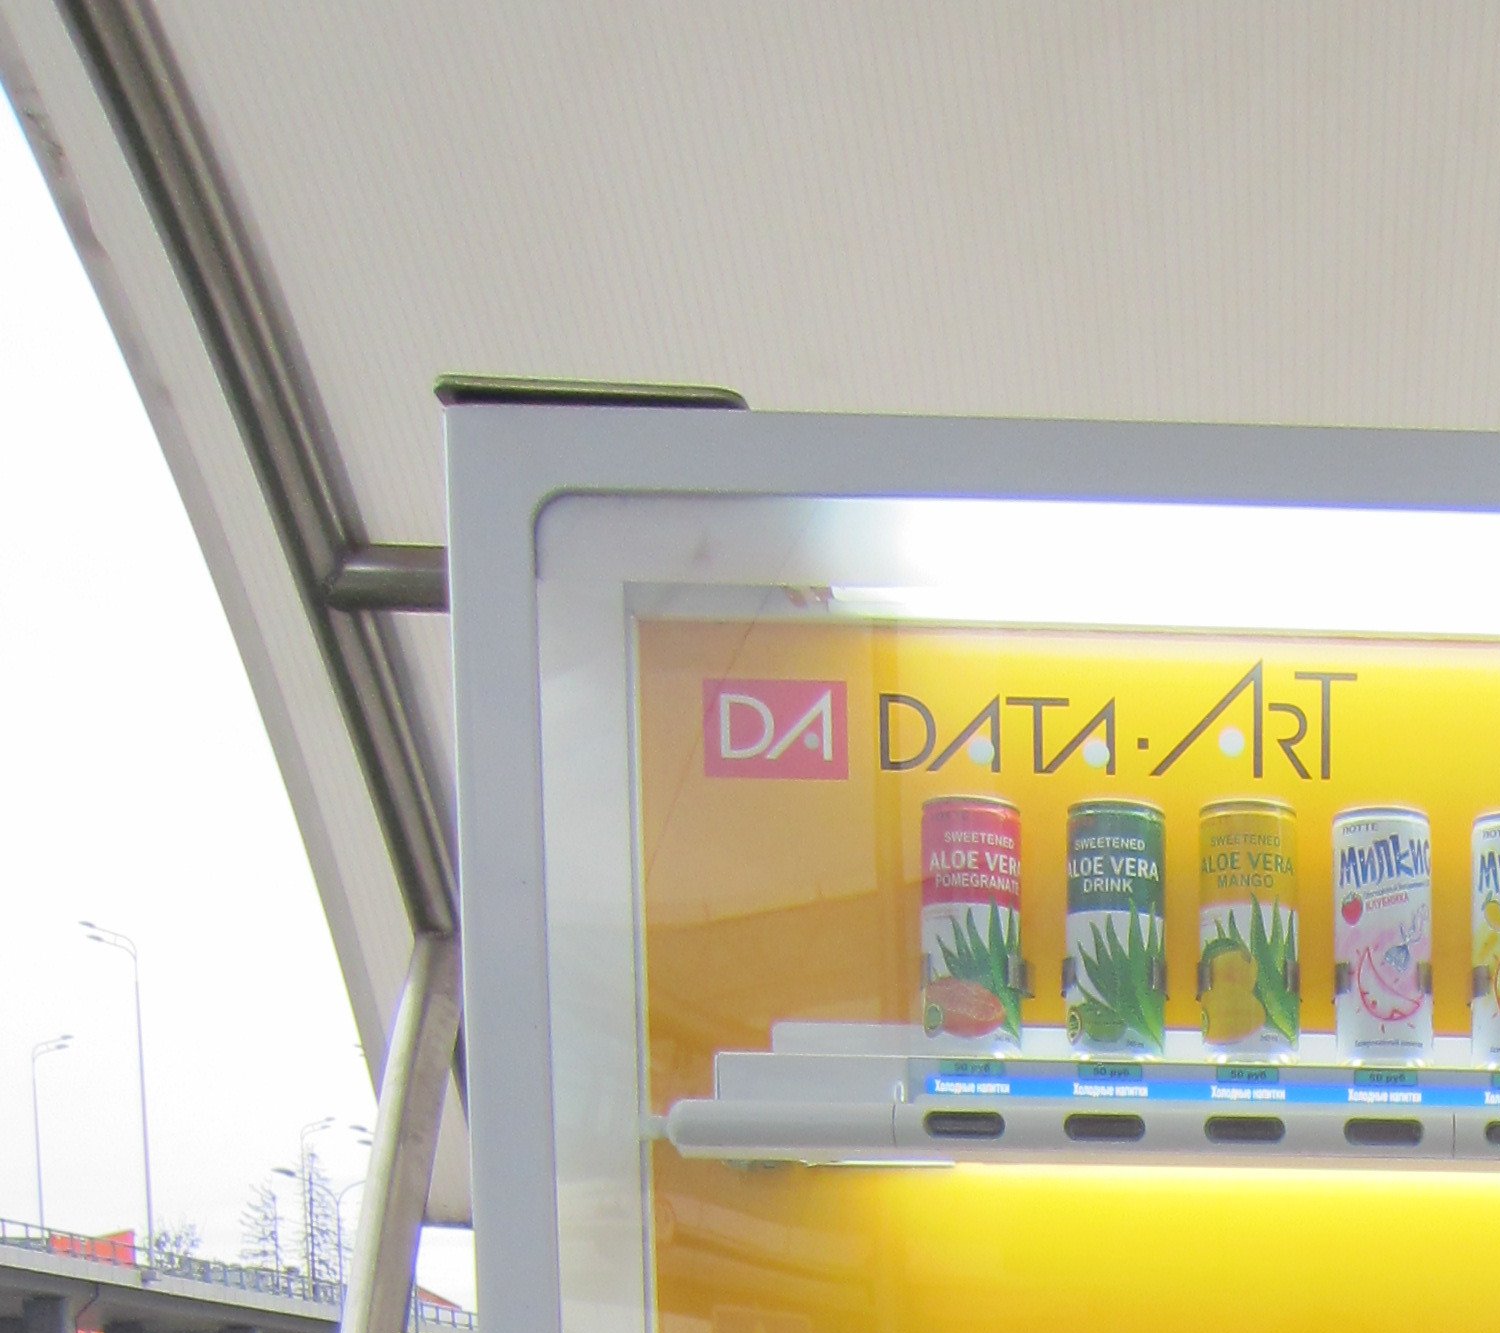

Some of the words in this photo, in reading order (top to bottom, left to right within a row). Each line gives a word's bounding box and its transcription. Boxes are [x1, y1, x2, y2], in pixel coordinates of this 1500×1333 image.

[720, 692, 833, 761] DA
[945, 830, 1015, 850] SWEETENED
[1074, 836, 1146, 852] SWEETENED
[1210, 833, 1281, 847] SWEETENED
[929, 849, 979, 871] ALOE
[1110, 857, 1159, 882] VERA
[1200, 851, 1241, 874] ALOE
[1246, 852, 1294, 876] VERA
[935, 873, 1020, 896] POMEGRANATE
[1083, 877, 1134, 894] DRINK
[1217, 873, 1274, 890] MANGO
